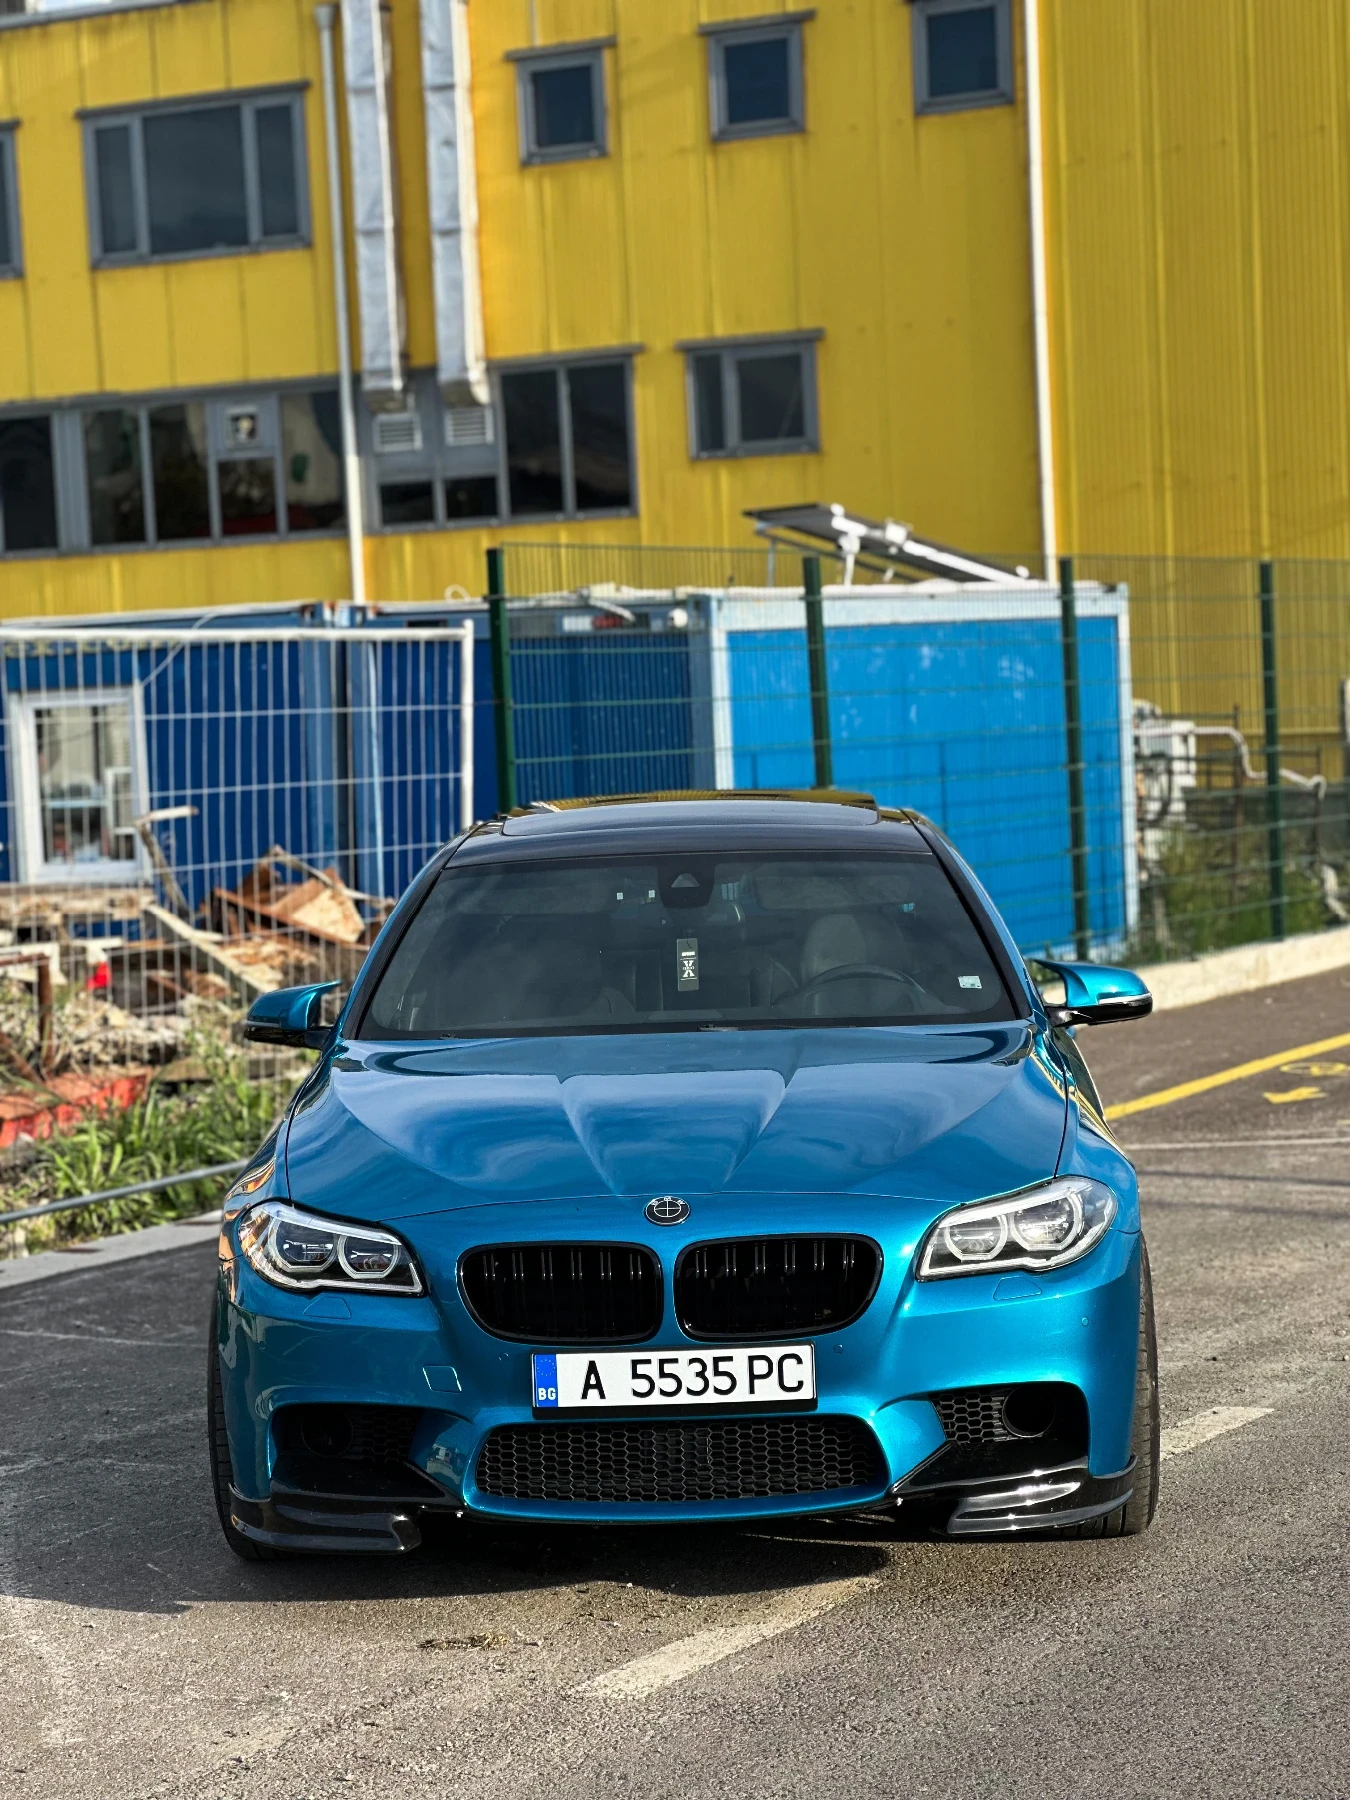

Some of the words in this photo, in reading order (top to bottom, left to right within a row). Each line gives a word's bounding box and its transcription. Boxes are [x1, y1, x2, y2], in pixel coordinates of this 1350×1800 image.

[580, 1360, 606, 1400] A
[630, 1356, 738, 1398] 5535
[748, 1353, 804, 1394] PC
[538, 1387, 556, 1401] BG
